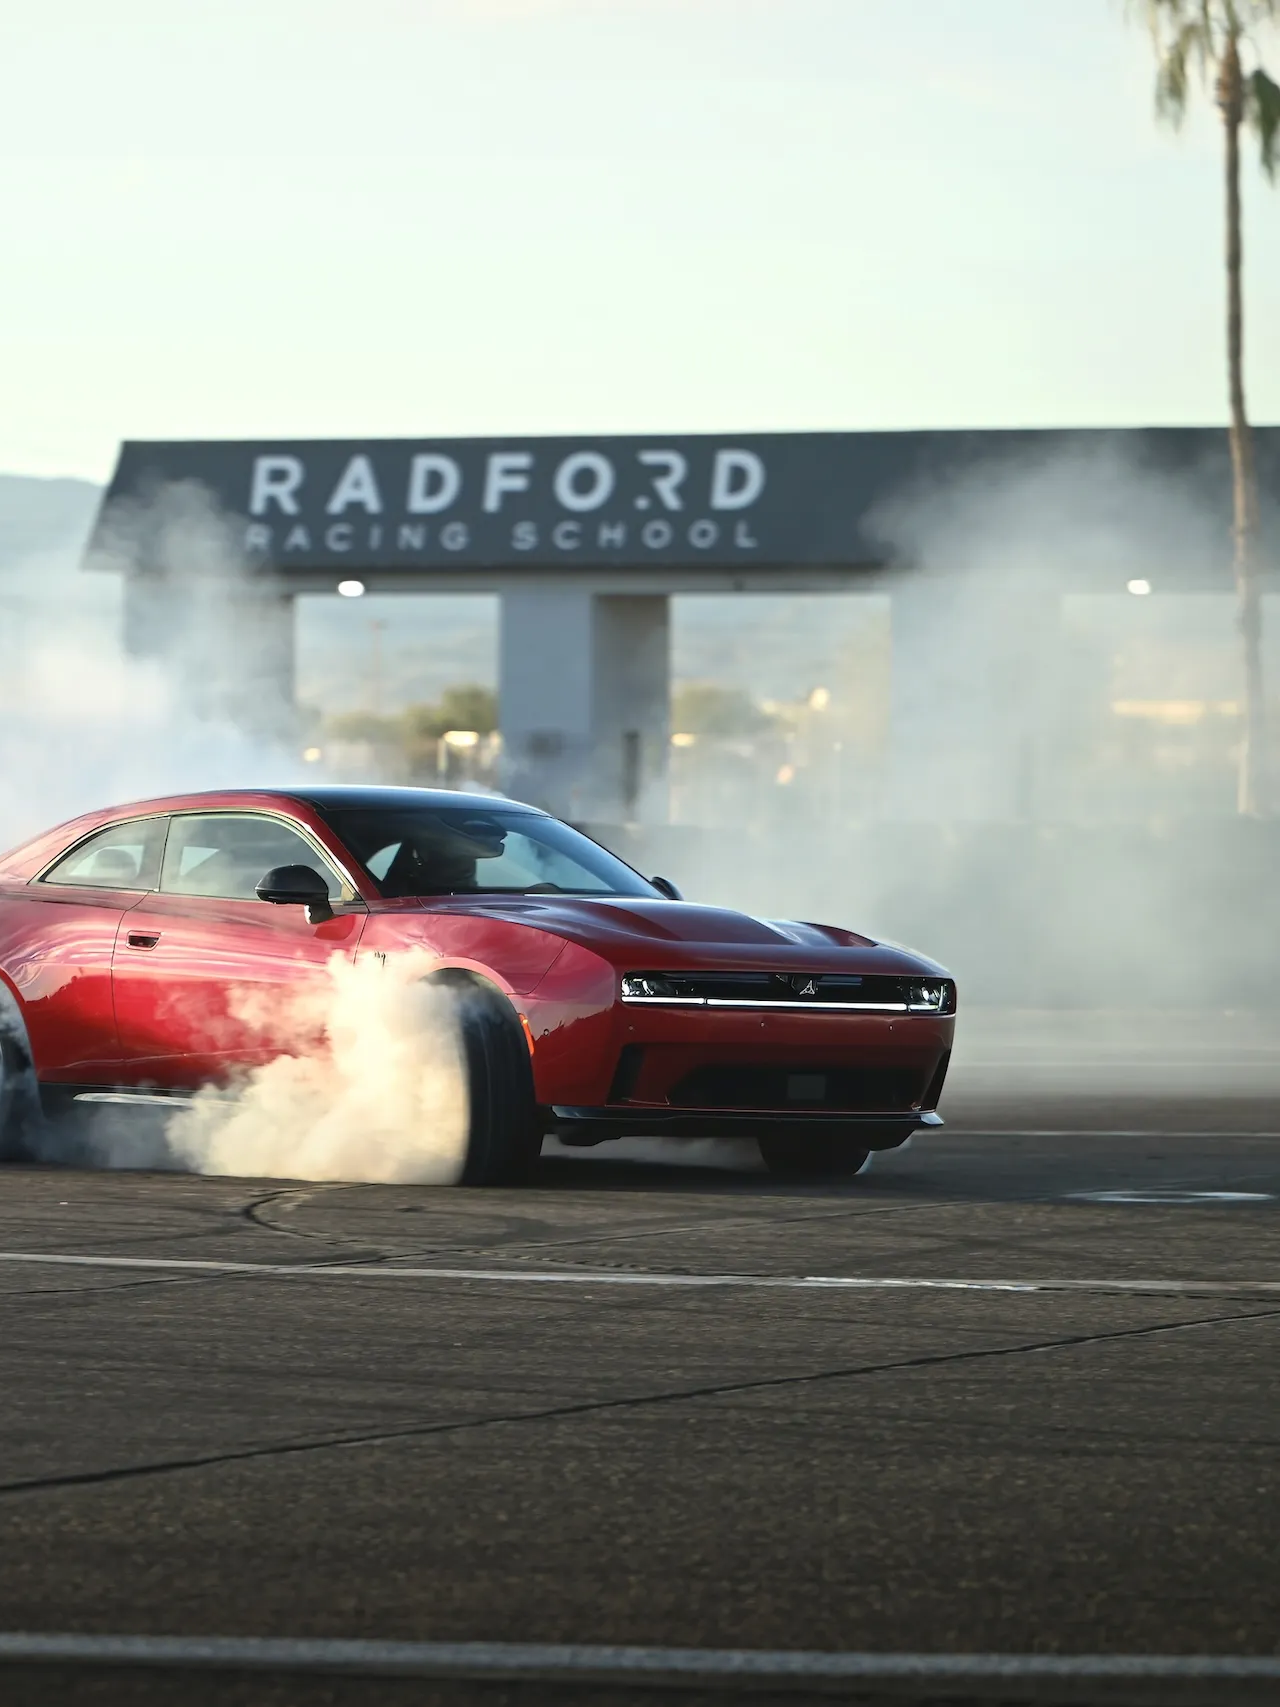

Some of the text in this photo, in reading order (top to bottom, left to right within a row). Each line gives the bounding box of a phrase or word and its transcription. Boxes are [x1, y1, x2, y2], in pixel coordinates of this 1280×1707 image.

[249, 450, 766, 515] RADFORD
[244, 518, 758, 552] RACING SCHOOL
